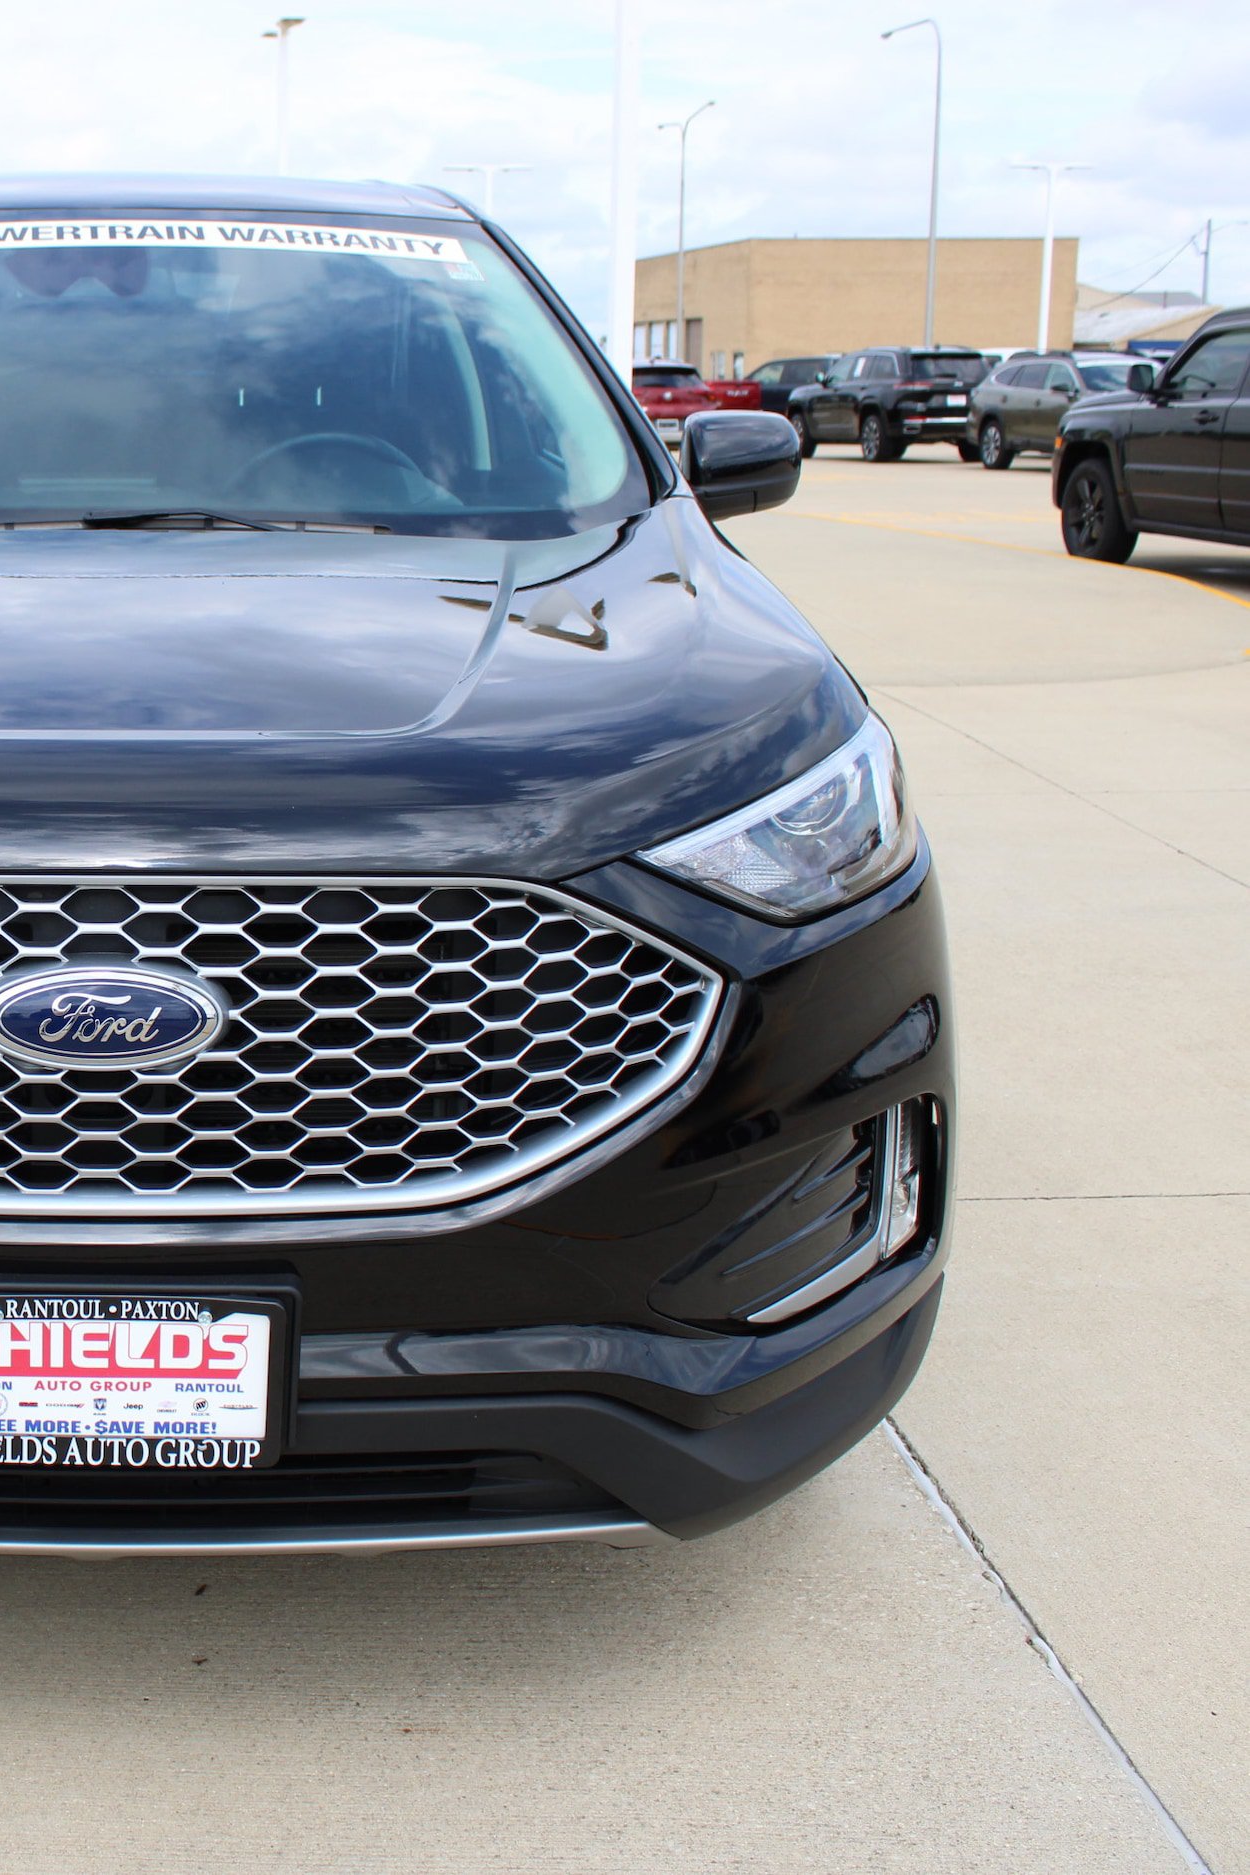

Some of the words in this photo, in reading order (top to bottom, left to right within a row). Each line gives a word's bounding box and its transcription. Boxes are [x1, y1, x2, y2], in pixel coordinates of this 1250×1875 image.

[218, 226, 444, 255] WARRANTY
[38, 992, 162, 1042] Ford
[5, 1299, 104, 1319] RANTOUL
[121, 1301, 200, 1321] PAXTON
[34, 1380, 82, 1391] AUTO
[90, 1381, 152, 1392] GROUP
[175, 1383, 244, 1393] RANTOUL
[123, 1402, 143, 1410] Jeep
[25, 1420, 81, 1433] MORE
[153, 1421, 217, 1434] MORE!
[64, 1437, 149, 1466] AUTO
[155, 1438, 261, 1469] GROUP
